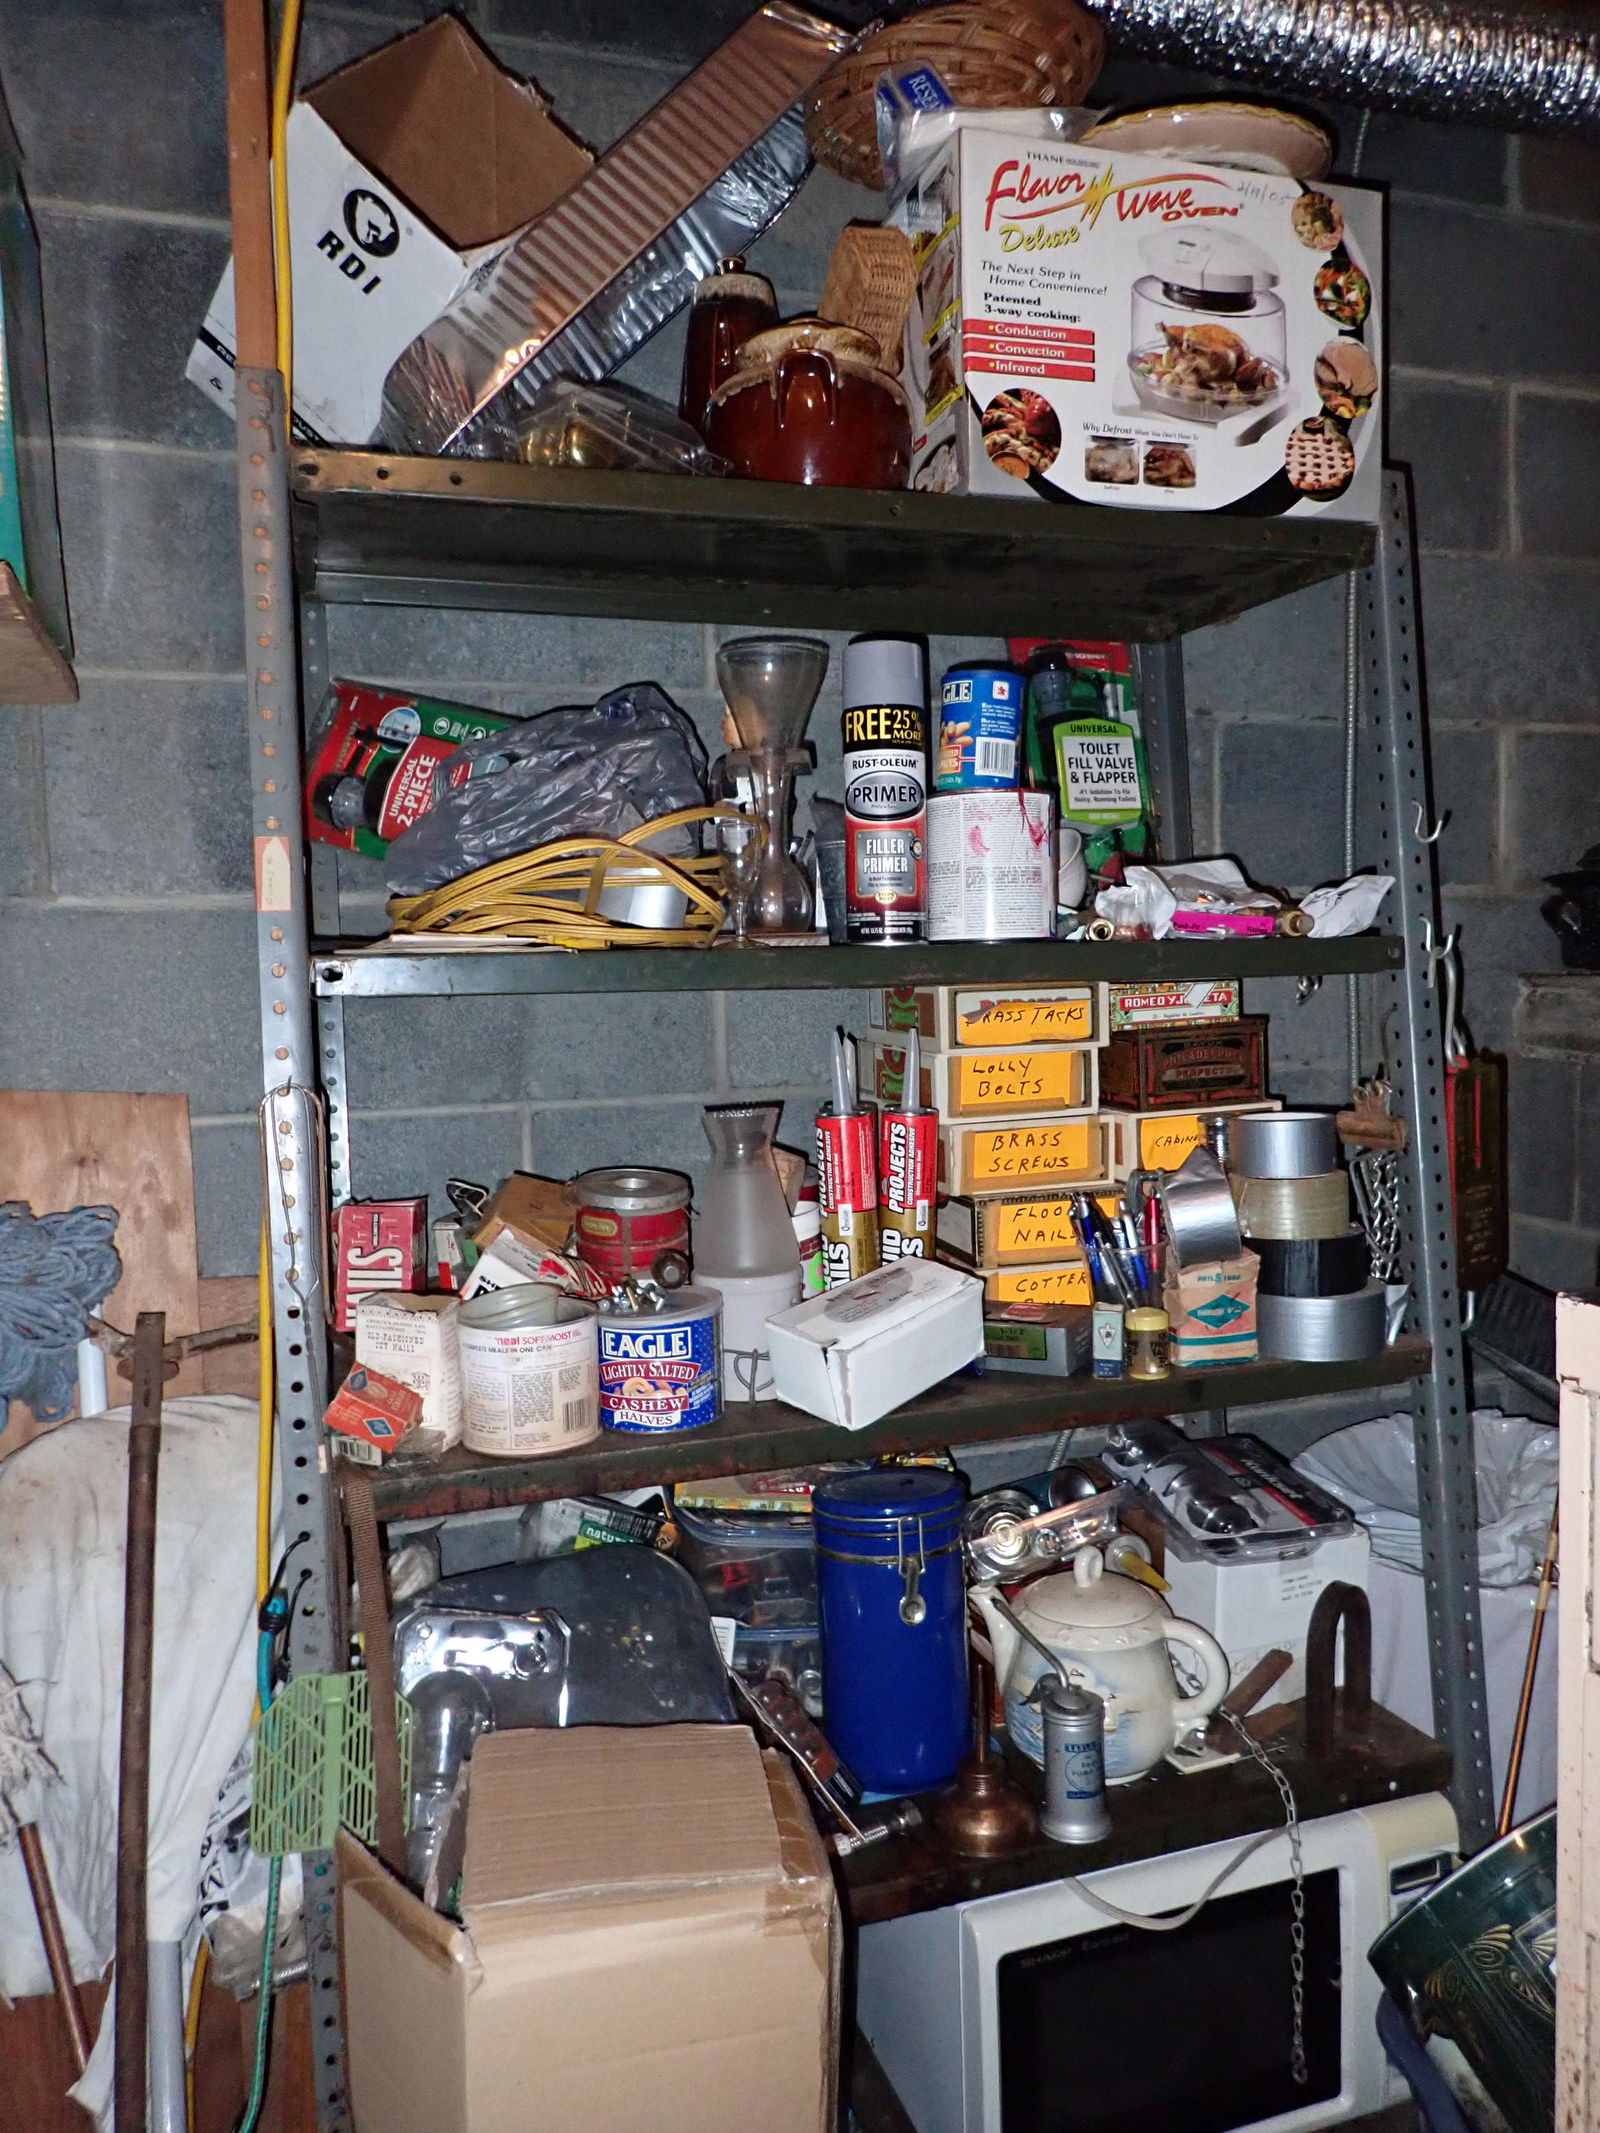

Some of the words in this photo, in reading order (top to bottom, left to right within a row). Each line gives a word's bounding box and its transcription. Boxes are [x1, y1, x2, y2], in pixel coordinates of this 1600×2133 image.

[985, 159, 1086, 232] Flavor
[1116, 187, 1194, 221] Wave
[1161, 205, 1239, 222] OVEN
[999, 223, 1081, 253] Deluxe
[316, 230, 382, 295] RDI
[981, 260, 1002, 272] The
[1007, 263, 1035, 276] Next
[1039, 267, 1066, 281] Step
[1069, 270, 1081, 280] in
[989, 274, 1025, 287] Home
[1029, 278, 1108, 296] Convenience!
[983, 292, 1042, 306] Patented
[984, 304, 1023, 318] 3-way
[1027, 309, 1082, 323] cooking:
[995, 323, 1067, 340] Conduction
[995, 342, 1065, 358] Convection
[995, 360, 1046, 374] Infrared
[1082, 422, 1100, 433] Why
[1102, 424, 1132, 435] Defrost
[942, 683, 970, 704] GLE
[845, 708, 892, 744] FREE
[1070, 724, 1118, 733] UNIVERSAL
[1079, 743, 1121, 755] TOILET
[852, 758, 917, 770] RUST-OLEUM
[1068, 757, 1092, 769] FILL
[1095, 757, 1135, 769] VALVE
[1070, 771, 1080, 783] &
[1083, 771, 1137, 784] FLAPPER
[388, 758, 418, 817] UNIVERSAL
[396, 754, 436, 828] 2-PIECE
[853, 786, 918, 804] PRIMER
[866, 838, 905, 855] FILLER
[863, 856, 908, 873] PRIMER
[1124, 995, 1166, 1008] ROMEO
[967, 1007, 1026, 1026] RASS
[1031, 1006, 1085, 1025] TACKS
[972, 1058, 1033, 1077] LOLLY
[978, 1078, 1044, 1098] BOLTS
[908, 1127, 916, 1160] ADHESIVE
[991, 1131, 1062, 1152] BRASS
[888, 1121, 907, 1214] PROJECTS
[988, 1156, 1070, 1174] SCREWS
[907, 1159, 915, 1206] CONSTRUCTION
[1012, 1206, 1072, 1223] FLOO
[1014, 1228, 1077, 1245] NAIL
[1015, 1271, 1088, 1293] COTTER
[605, 1332, 687, 1358] EAGLE
[602, 1363, 646, 1380] LIGHTLY
[649, 1361, 695, 1380] SALTED
[609, 1397, 685, 1411] CASHEW
[619, 1411, 674, 1425] HALVES
[586, 1527, 634, 1543] natu
